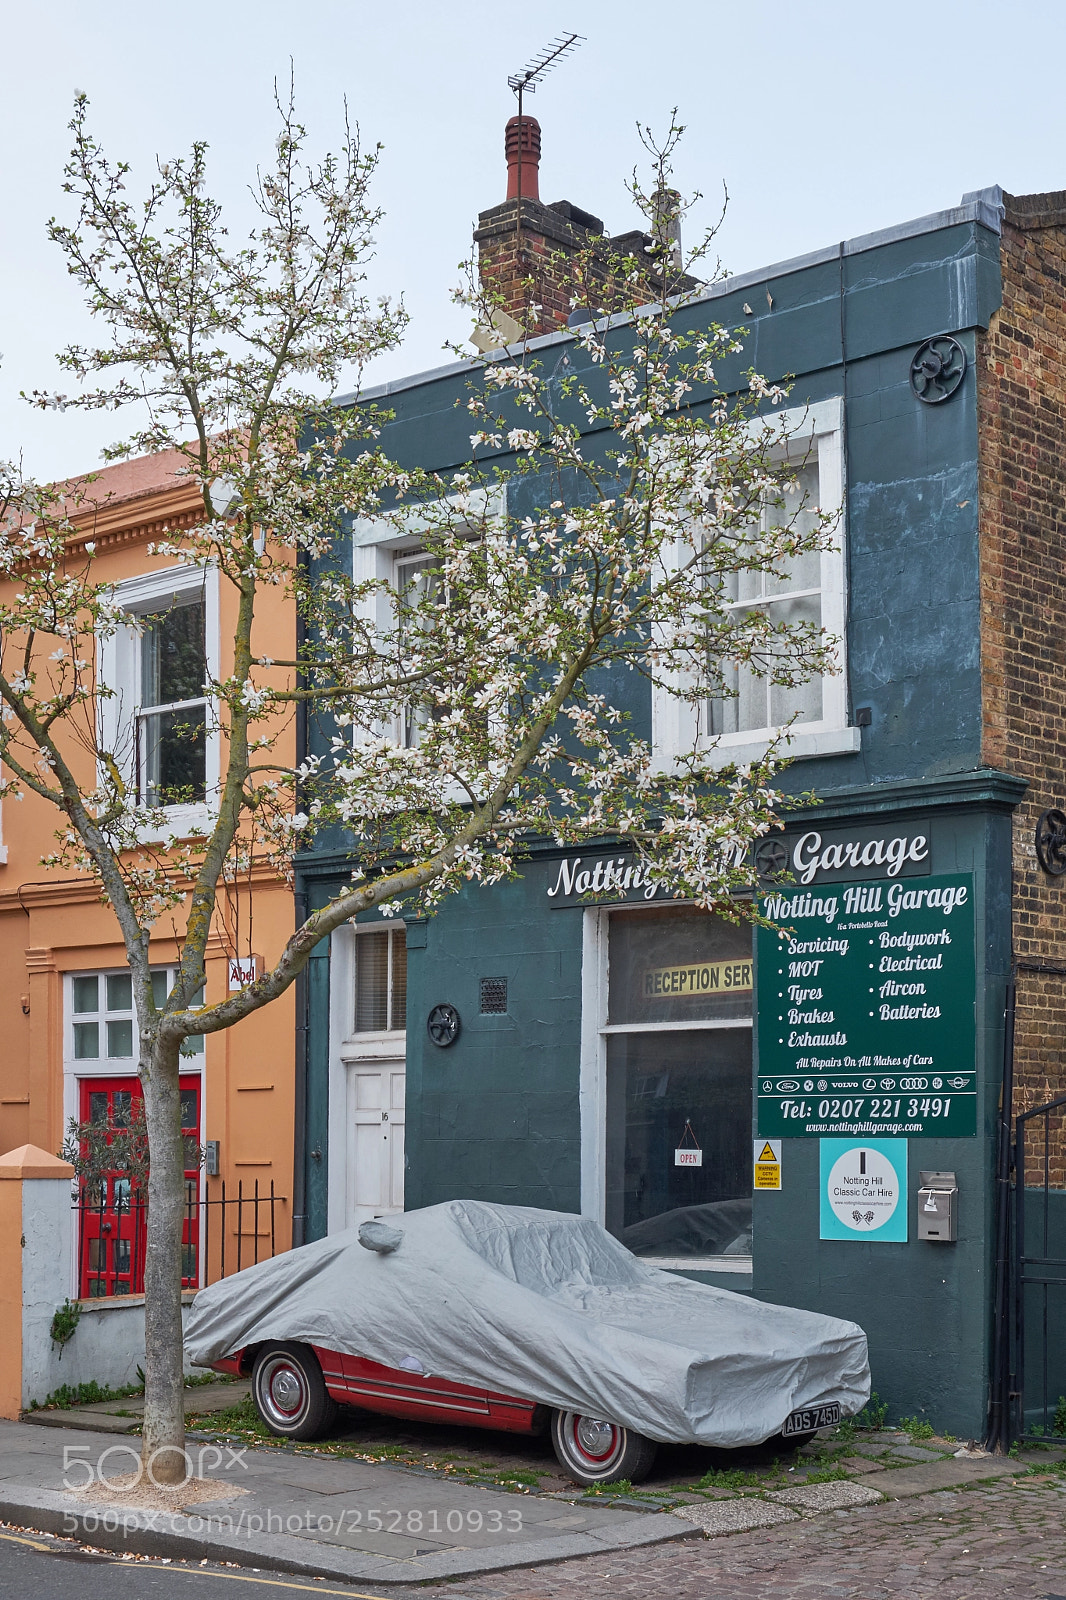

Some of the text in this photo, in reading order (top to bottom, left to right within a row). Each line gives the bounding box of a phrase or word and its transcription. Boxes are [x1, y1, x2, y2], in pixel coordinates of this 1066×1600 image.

[793, 831, 929, 884] Garage
[763, 883, 968, 924] Notting Hill Garage
[874, 920, 888, 928] Road
[787, 937, 850, 956] Servicing
[878, 928, 952, 951] Bodywork
[788, 960, 824, 978] MOT
[878, 953, 943, 973] Electrical
[230, 966, 255, 982] Abel
[645, 963, 753, 995] RECEPTION SER
[787, 984, 823, 1005] Tyres
[878, 979, 927, 999] Aircon
[787, 1008, 835, 1025] Brakes
[878, 1002, 941, 1020] Batteries
[787, 1031, 848, 1048] Exhausts
[795, 1054, 933, 1071] All Repairs On All Makes of Cars
[381, 1111, 389, 1122] 16
[780, 1098, 951, 1119] Tel: 0207 221 3491
[805, 1121, 924, 1135] www.nottinghillgarage.com
[680, 1154, 697, 1163] OPEN
[843, 1177, 883, 1187] Notting Hill
[833, 1188, 893, 1197] Classic Car Hire
[786, 1406, 839, 1432] ADS 745D
